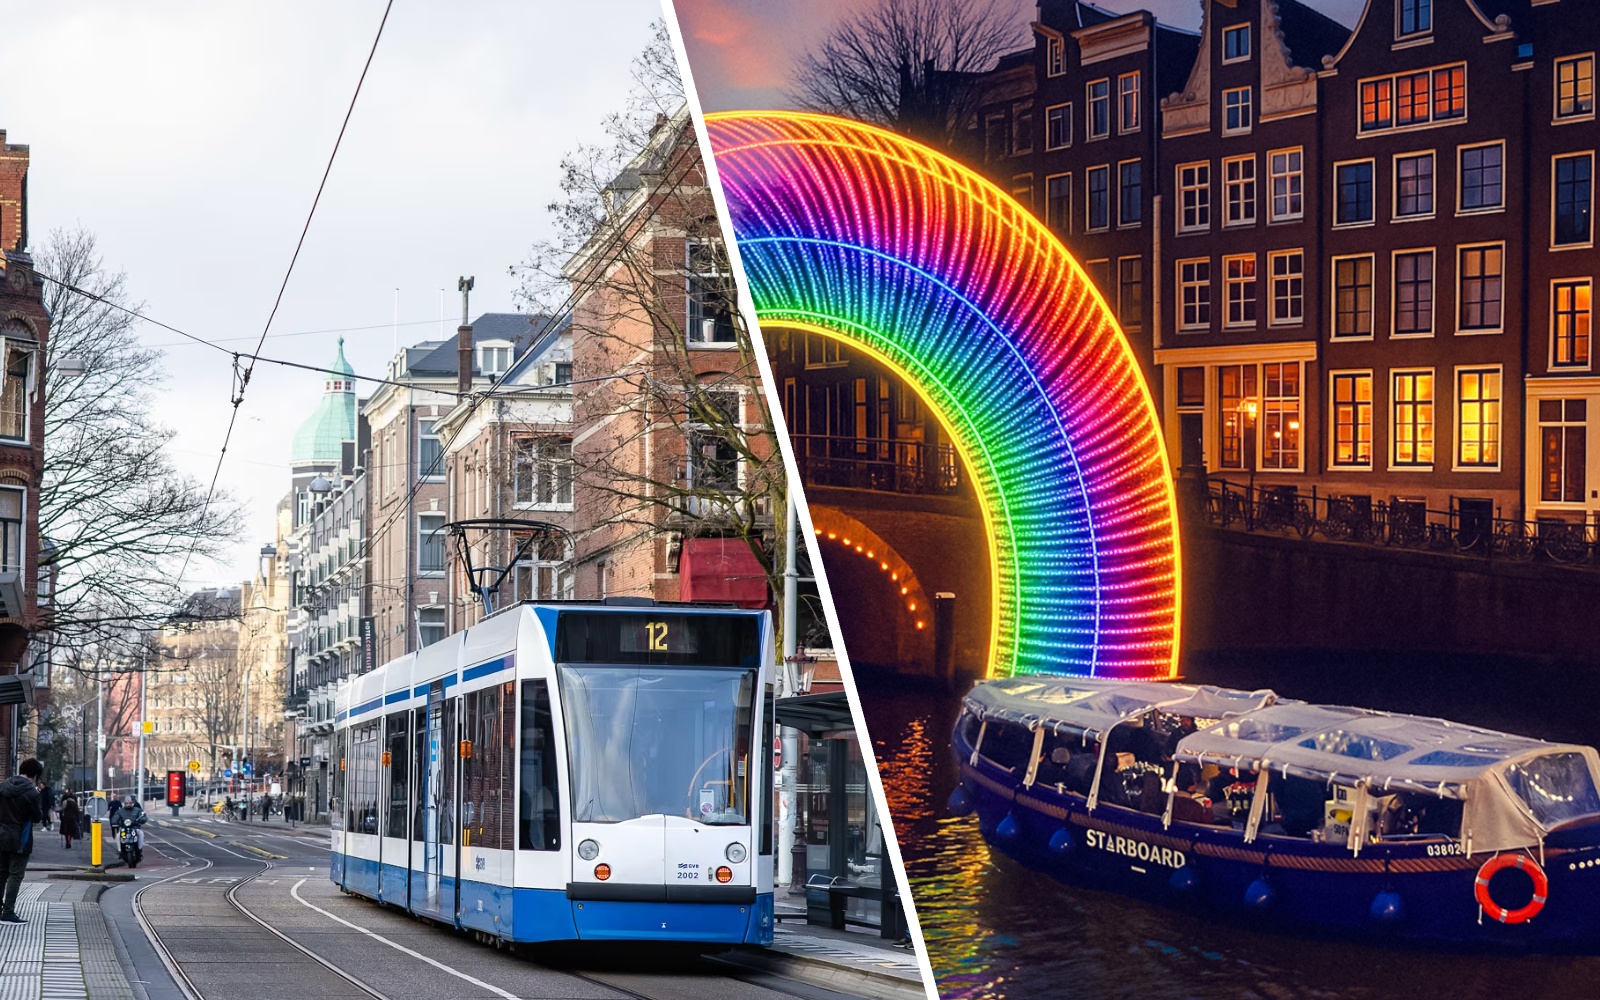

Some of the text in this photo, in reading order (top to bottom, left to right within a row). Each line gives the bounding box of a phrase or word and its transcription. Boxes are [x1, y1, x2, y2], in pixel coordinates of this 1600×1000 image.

[645, 622, 668, 650] 12
[1086, 828, 1186, 869] STARBOARD
[1427, 843, 1461, 856] 03802
